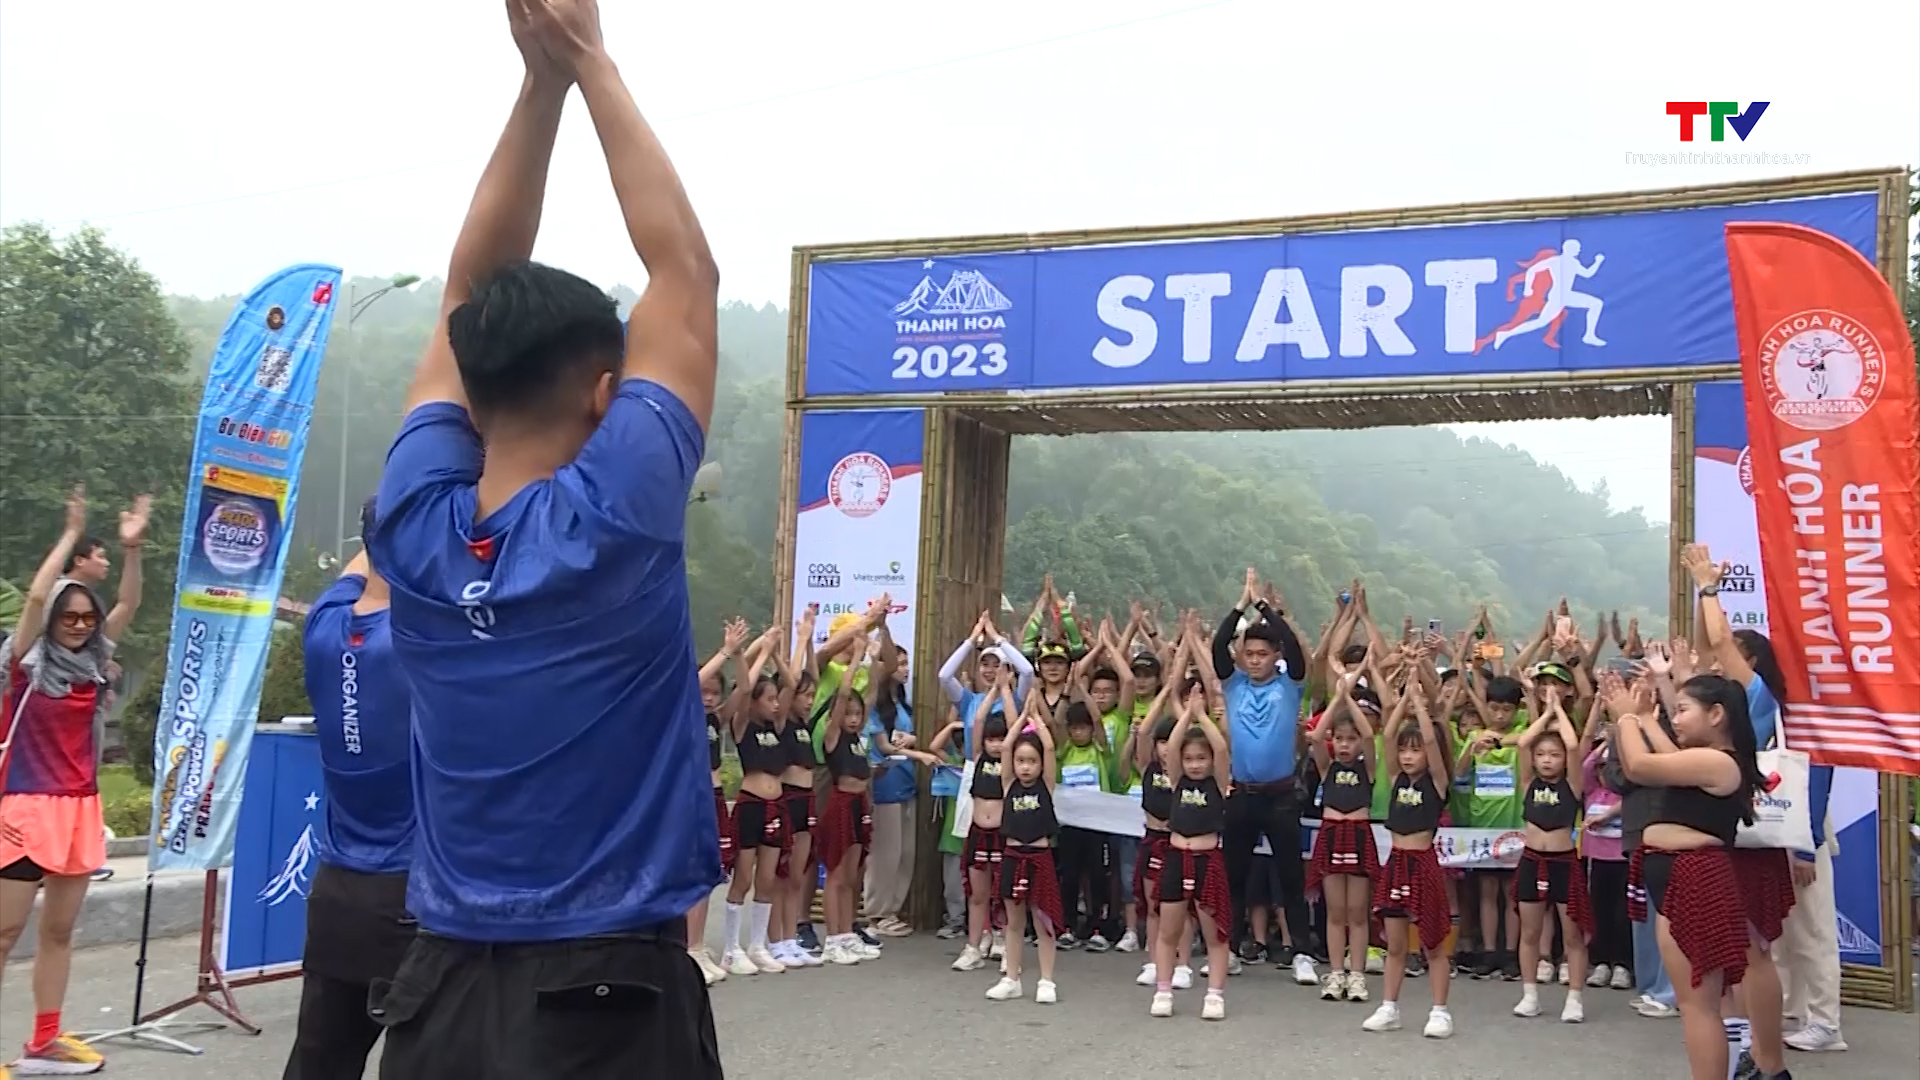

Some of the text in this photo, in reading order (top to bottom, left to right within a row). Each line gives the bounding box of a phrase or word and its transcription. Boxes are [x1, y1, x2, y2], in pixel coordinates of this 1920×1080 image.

[895, 315, 1006, 333] THANH HOA
[1092, 257, 1498, 368] START
[891, 342, 1008, 379] 2023
[1761, 315, 1881, 401] THANH HOA RUNNERS
[208, 522, 267, 546] SPORTS
[808, 563, 841, 574] COOL
[1777, 437, 1852, 700] THANH HÓA
[809, 576, 840, 587] MATE
[1722, 564, 1755, 576] OOL
[1841, 483, 1895, 674] RUNNER
[172, 617, 208, 739] SPORTS
[341, 651, 362, 755] ORGANIZER
[181, 730, 207, 799] Powder
